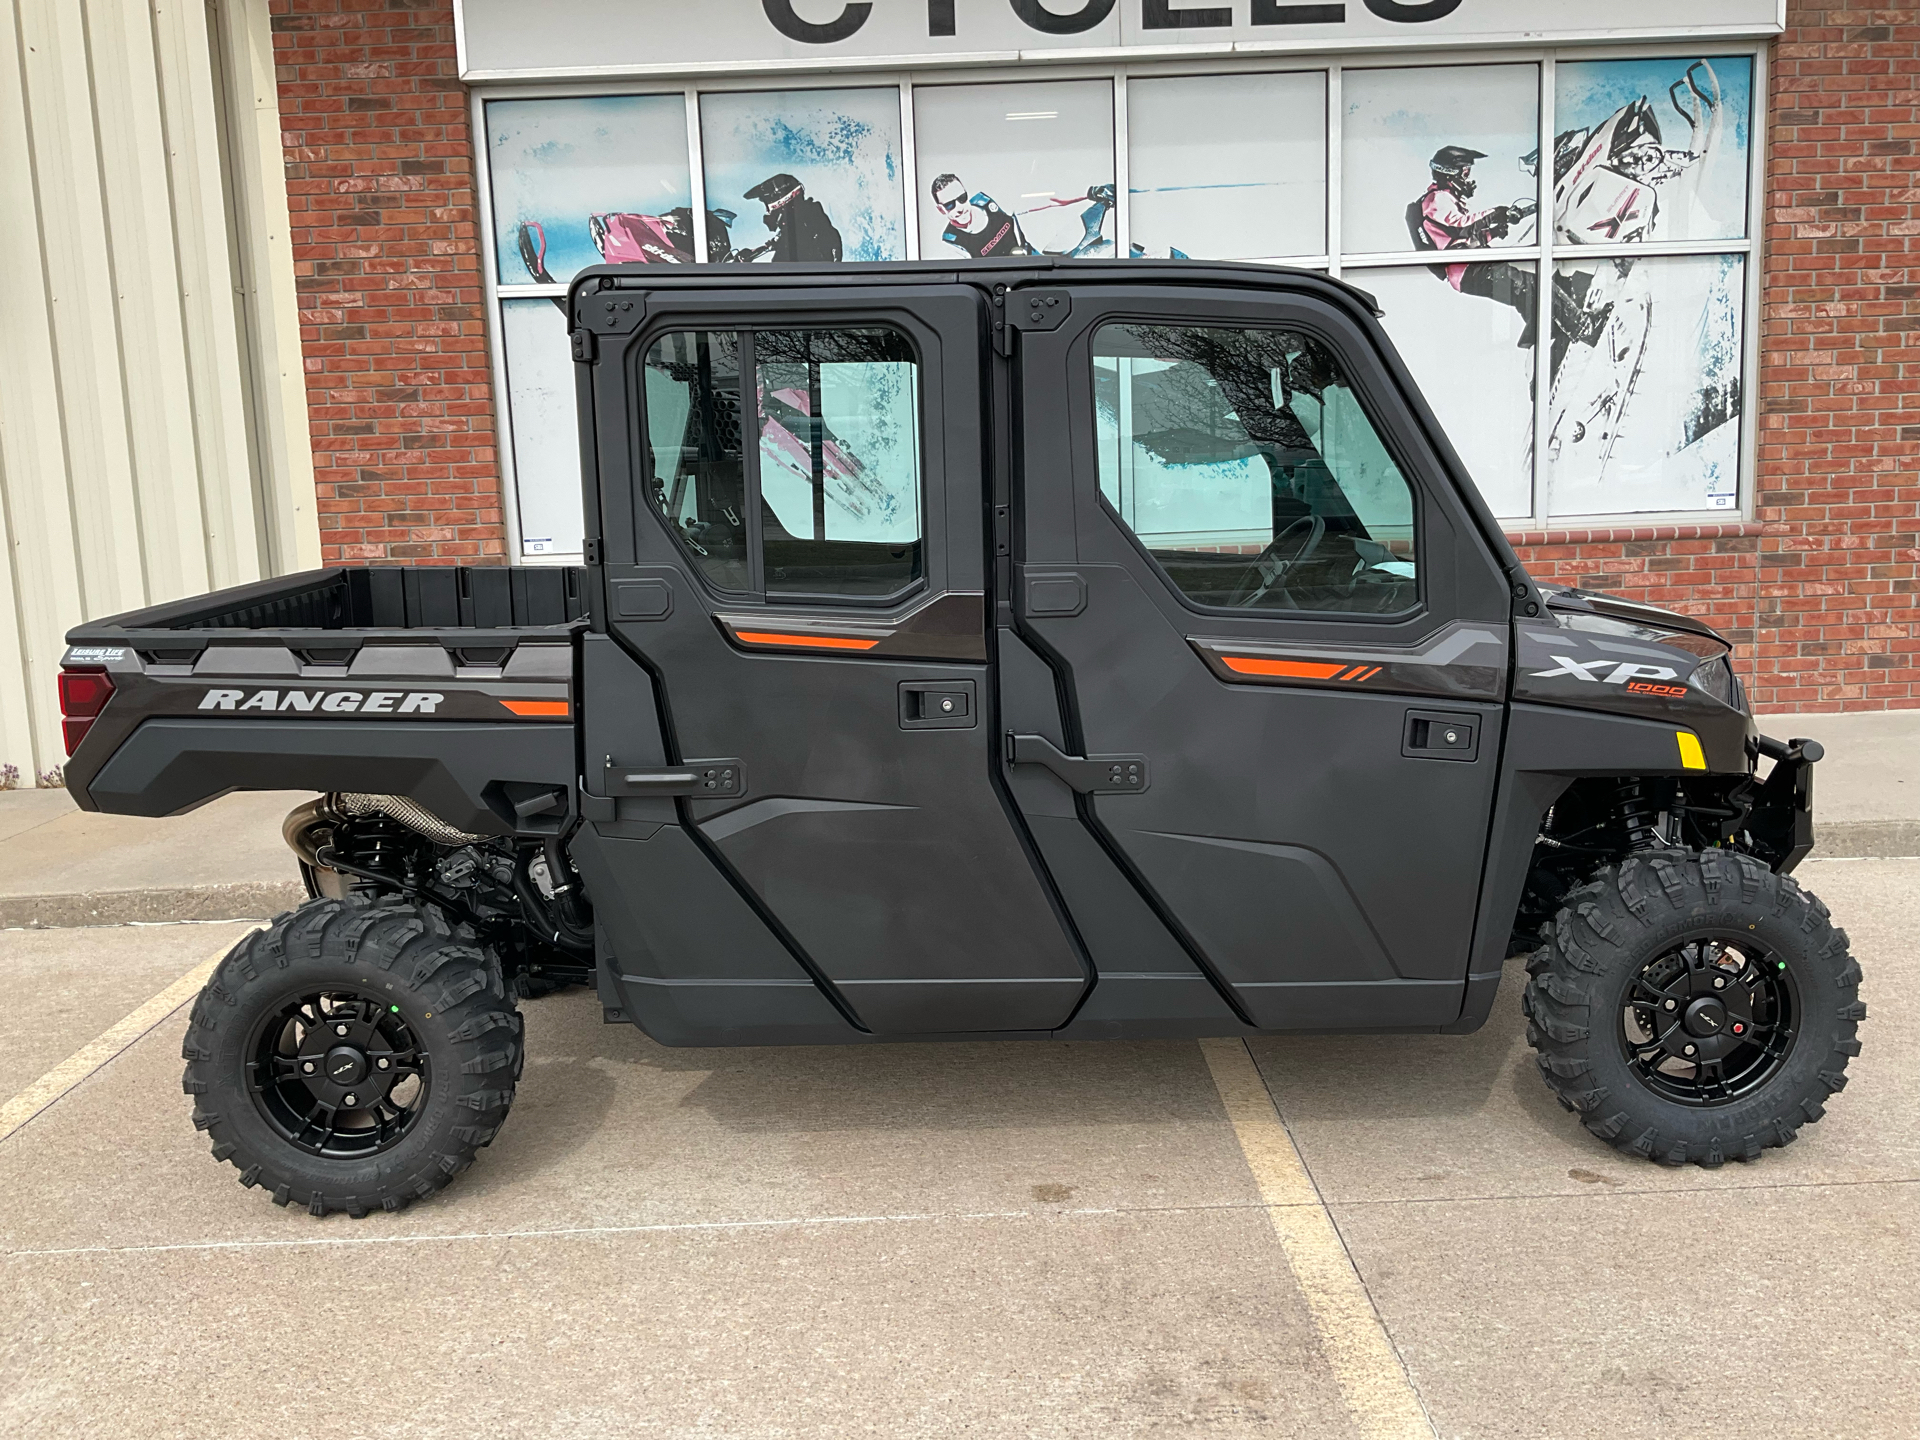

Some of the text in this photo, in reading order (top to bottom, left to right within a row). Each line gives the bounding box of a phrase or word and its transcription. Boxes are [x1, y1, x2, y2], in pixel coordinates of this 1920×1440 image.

[1572, 143, 1602, 186] ski-doo
[1527, 655, 1678, 685] XP
[197, 689, 444, 713] RANGER
[1627, 682, 1688, 695] 1000
